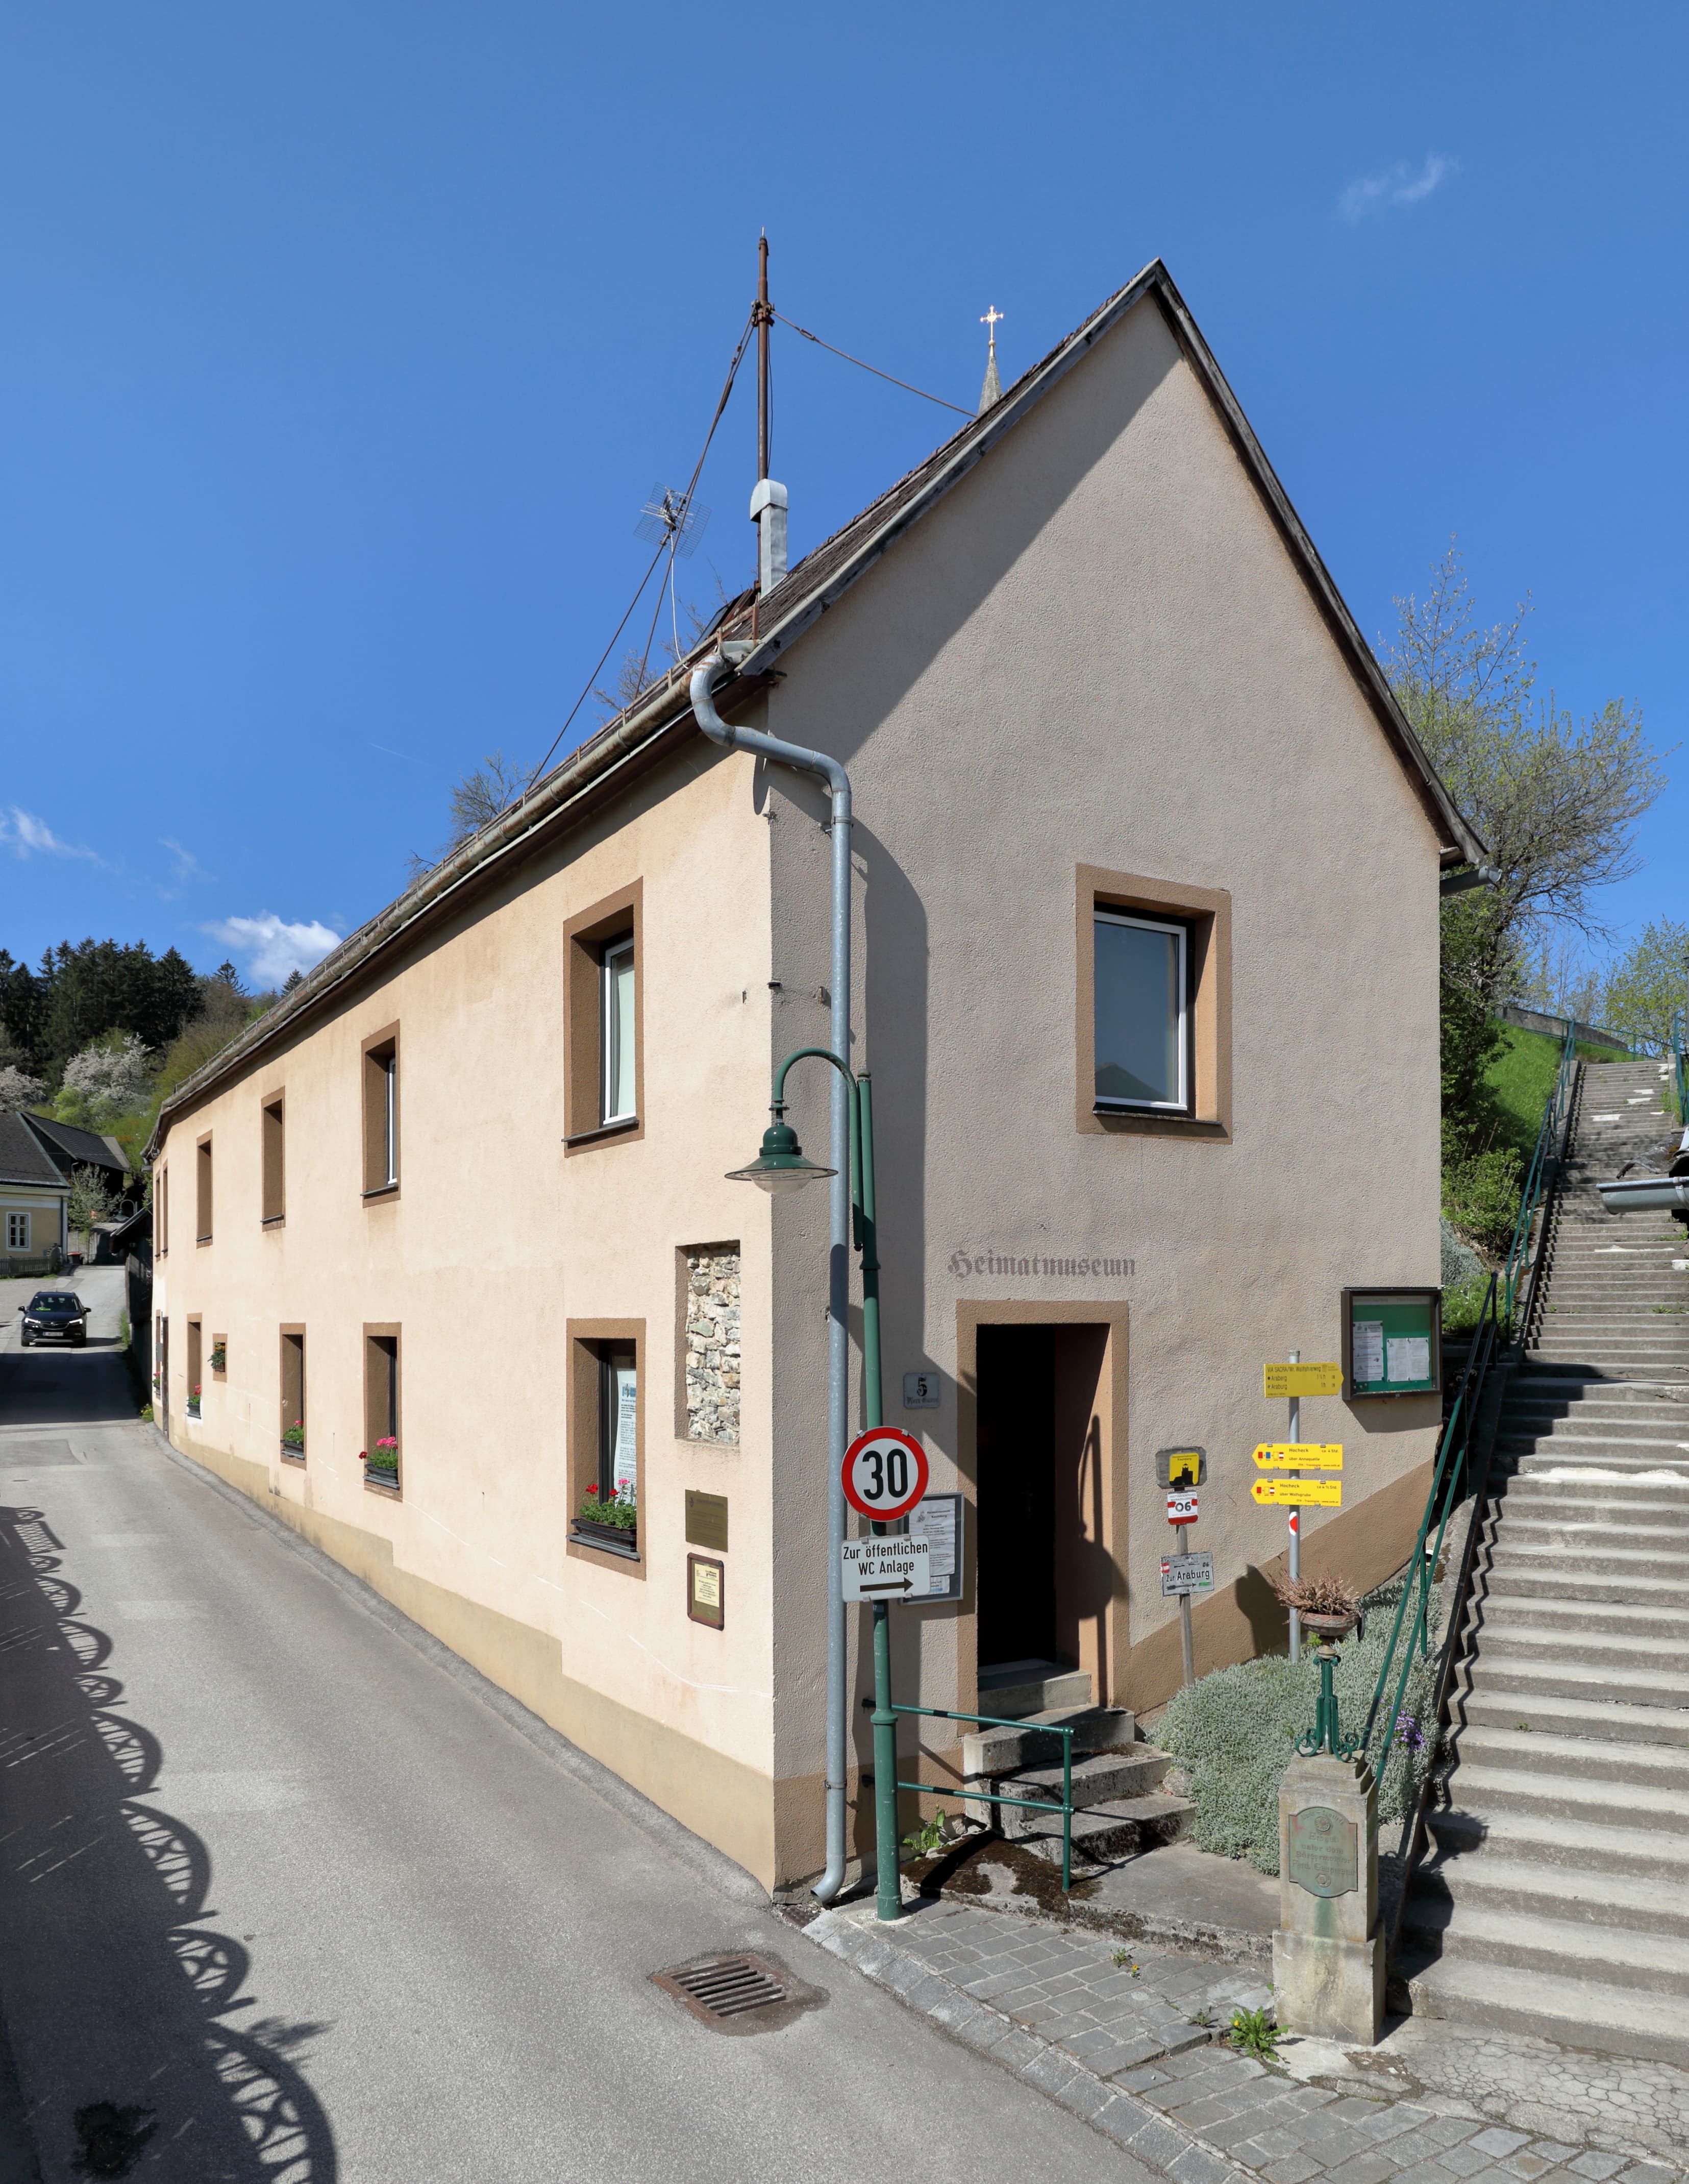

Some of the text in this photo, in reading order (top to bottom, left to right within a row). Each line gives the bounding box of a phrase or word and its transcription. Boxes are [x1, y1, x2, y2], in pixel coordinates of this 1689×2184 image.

[947, 1249, 1136, 1279] Heimatmuseum
[916, 1377, 928, 1396] 5
[862, 1449, 908, 1501] 30
[1175, 1502, 1191, 1512] 06
[843, 1547, 860, 1560] Zur
[865, 1541, 928, 1558] öffentlichen
[858, 1560, 914, 1576] WC Anlage
[1177, 1569, 1210, 1580] Araburg
[1326, 1846, 1344, 1854] dem
